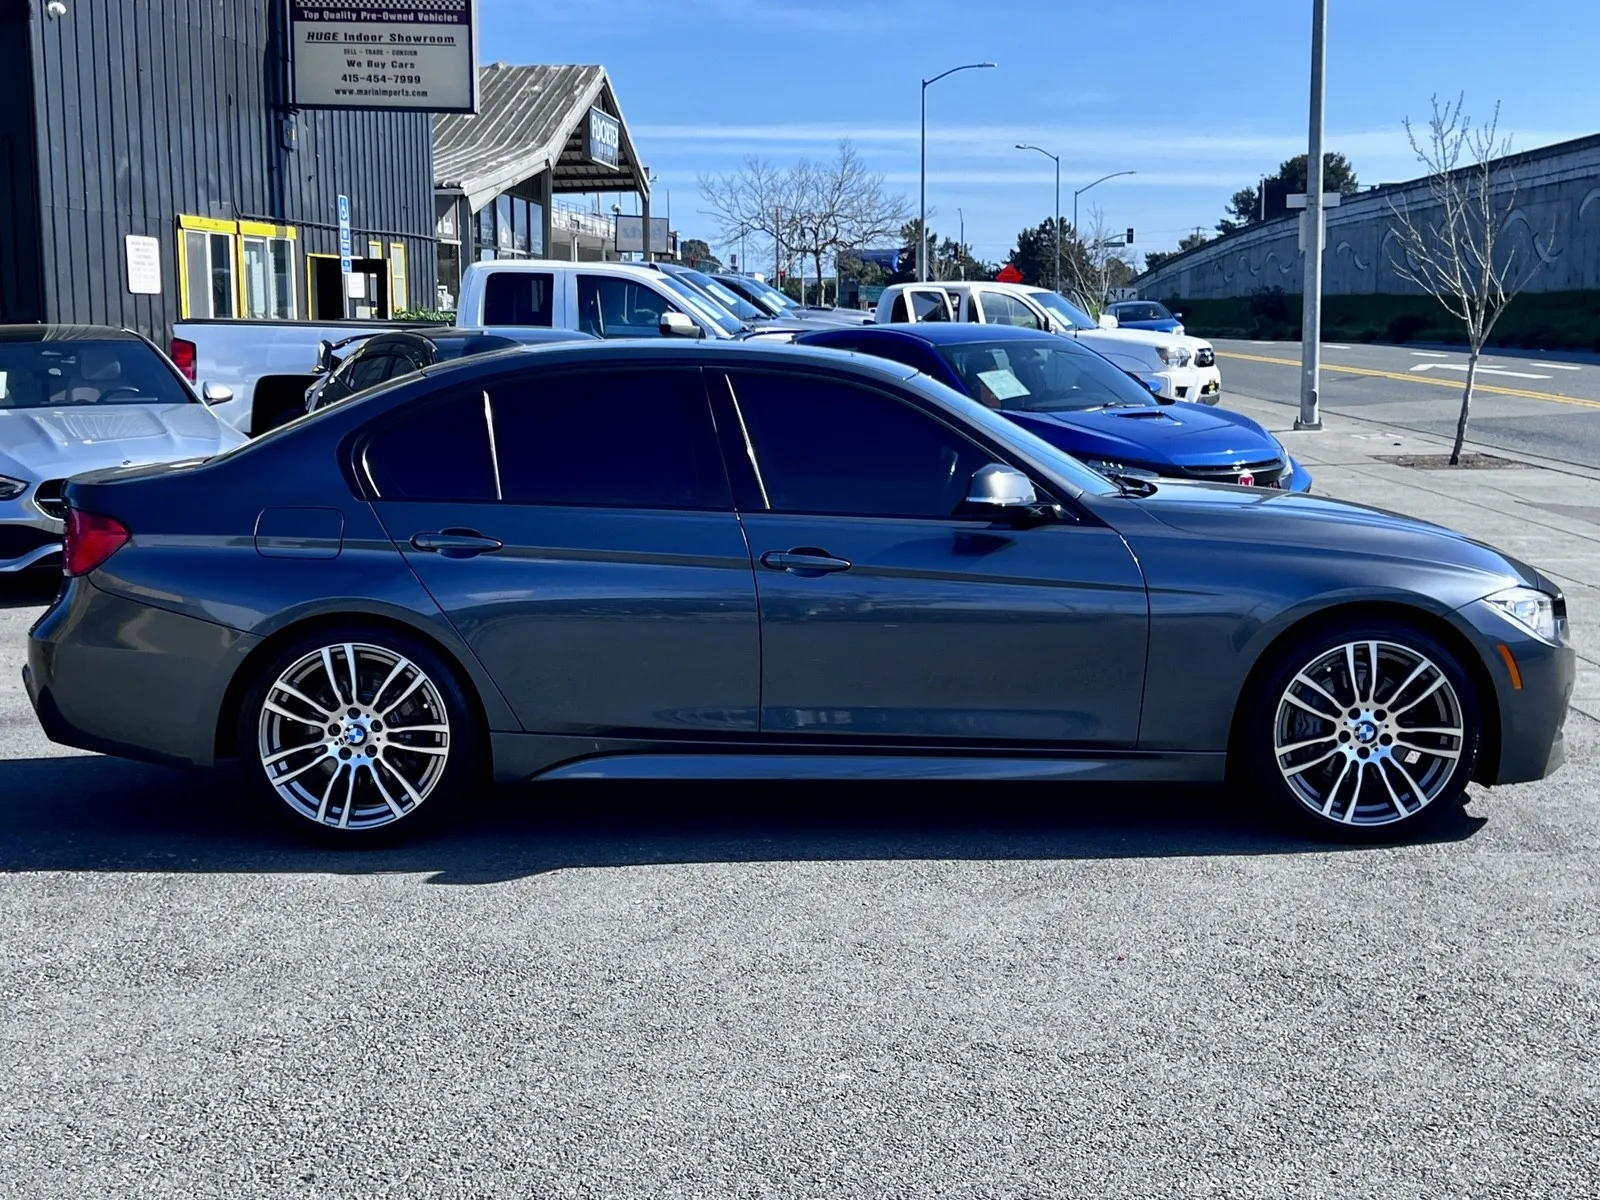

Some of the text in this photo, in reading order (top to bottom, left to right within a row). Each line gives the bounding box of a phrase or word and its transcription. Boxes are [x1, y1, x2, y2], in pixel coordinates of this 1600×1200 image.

[303, 10, 458, 23] Top Quality Pre-Owned Vehicles
[307, 31, 455, 44] HUGE Indoor Showroom
[346, 60, 415, 69] We Buy Cars
[341, 74, 421, 84] 415-454-7999
[334, 87, 428, 97] www.marinimports.com
